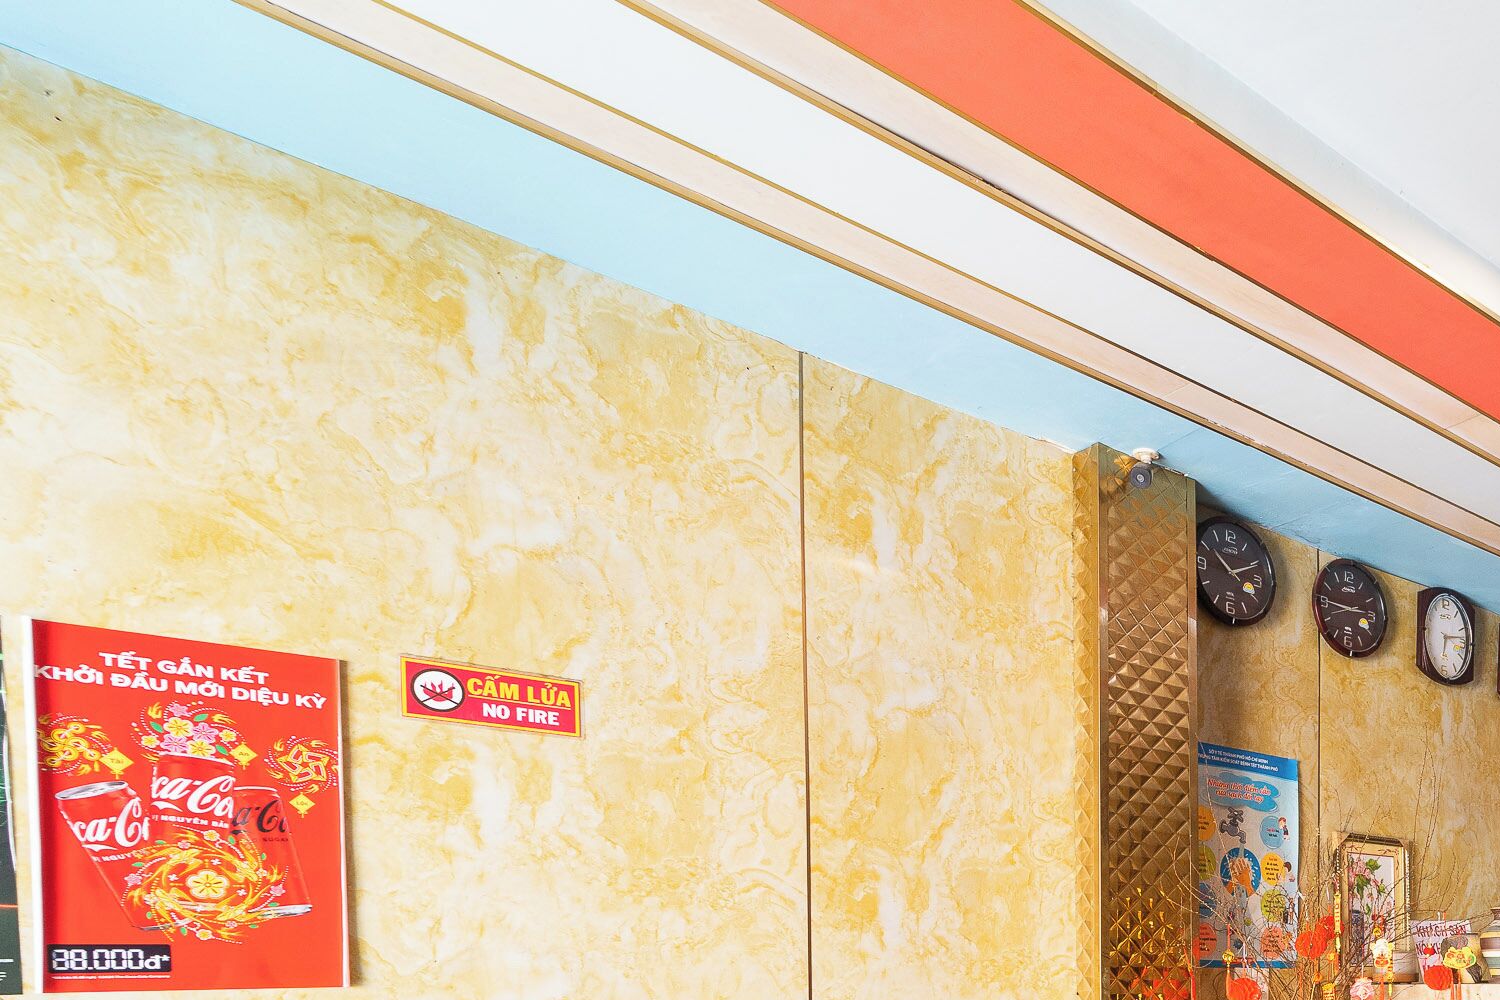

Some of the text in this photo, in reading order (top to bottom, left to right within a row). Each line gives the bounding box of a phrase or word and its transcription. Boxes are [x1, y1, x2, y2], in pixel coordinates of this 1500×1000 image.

[1225, 529, 1236, 544] 12
[1197, 556, 1206, 570] 9
[1253, 574, 1262, 588] 3
[1344, 571, 1354, 584] 12
[1225, 601, 1236, 615] 6
[1368, 611, 1376, 623] 3
[1343, 635, 1353, 648] 6
[98, 650, 270, 686] TẾT GẮN KẾT
[34, 663, 327, 710] KHỞI ĐẦU MỚI DIỆU KỲ
[466, 675, 572, 708] CẤM LỬA
[482, 702, 560, 726] NO FIRE
